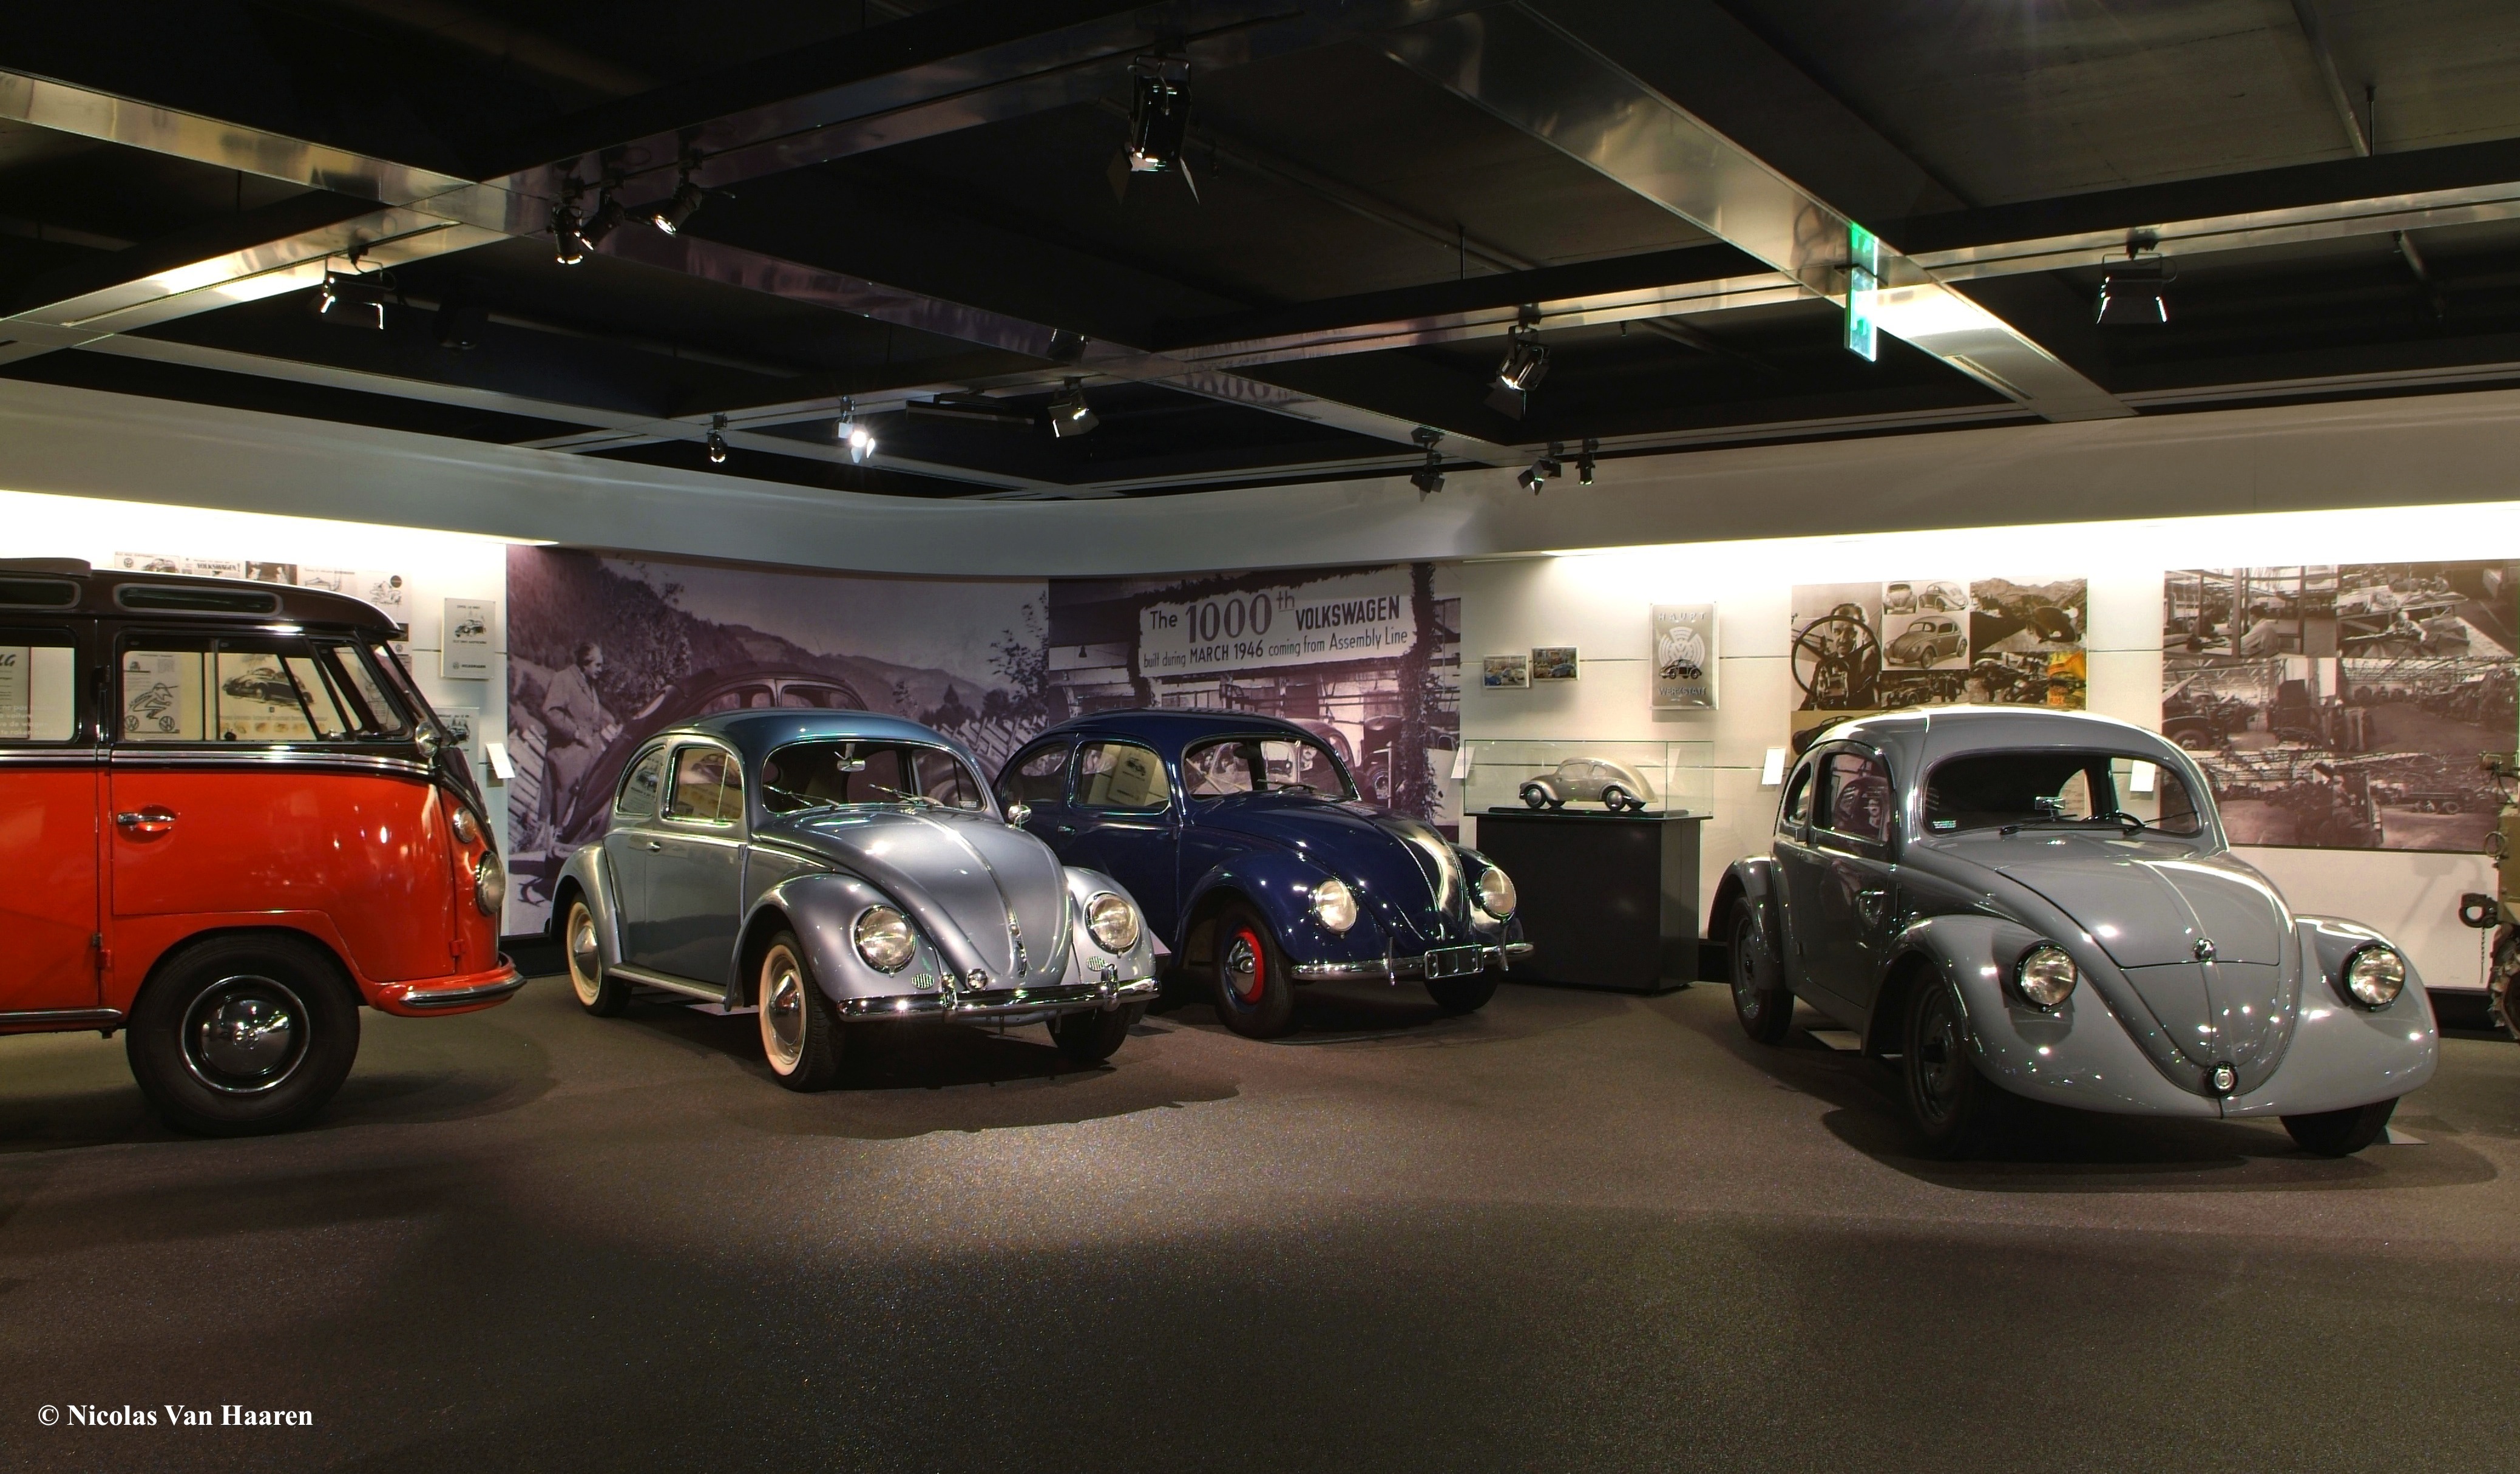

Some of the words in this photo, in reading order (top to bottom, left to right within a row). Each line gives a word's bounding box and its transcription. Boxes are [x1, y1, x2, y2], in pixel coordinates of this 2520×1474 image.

[1150, 611, 1177, 630] The
[1295, 595, 1400, 631] VOLKSWAGEN
[1659, 612, 1706, 620] HAUPT
[1143, 653, 1159, 668] built
[1162, 651, 1185, 667] during
[1190, 645, 1228, 664] MARCH
[1234, 639, 1264, 660] 1946
[1268, 639, 1300, 657] coming
[1304, 636, 1324, 653] from
[1329, 628, 1381, 650] Assembly
[1385, 627, 1407, 645] Line
[1659, 687, 1707, 696] WERKSTATT
